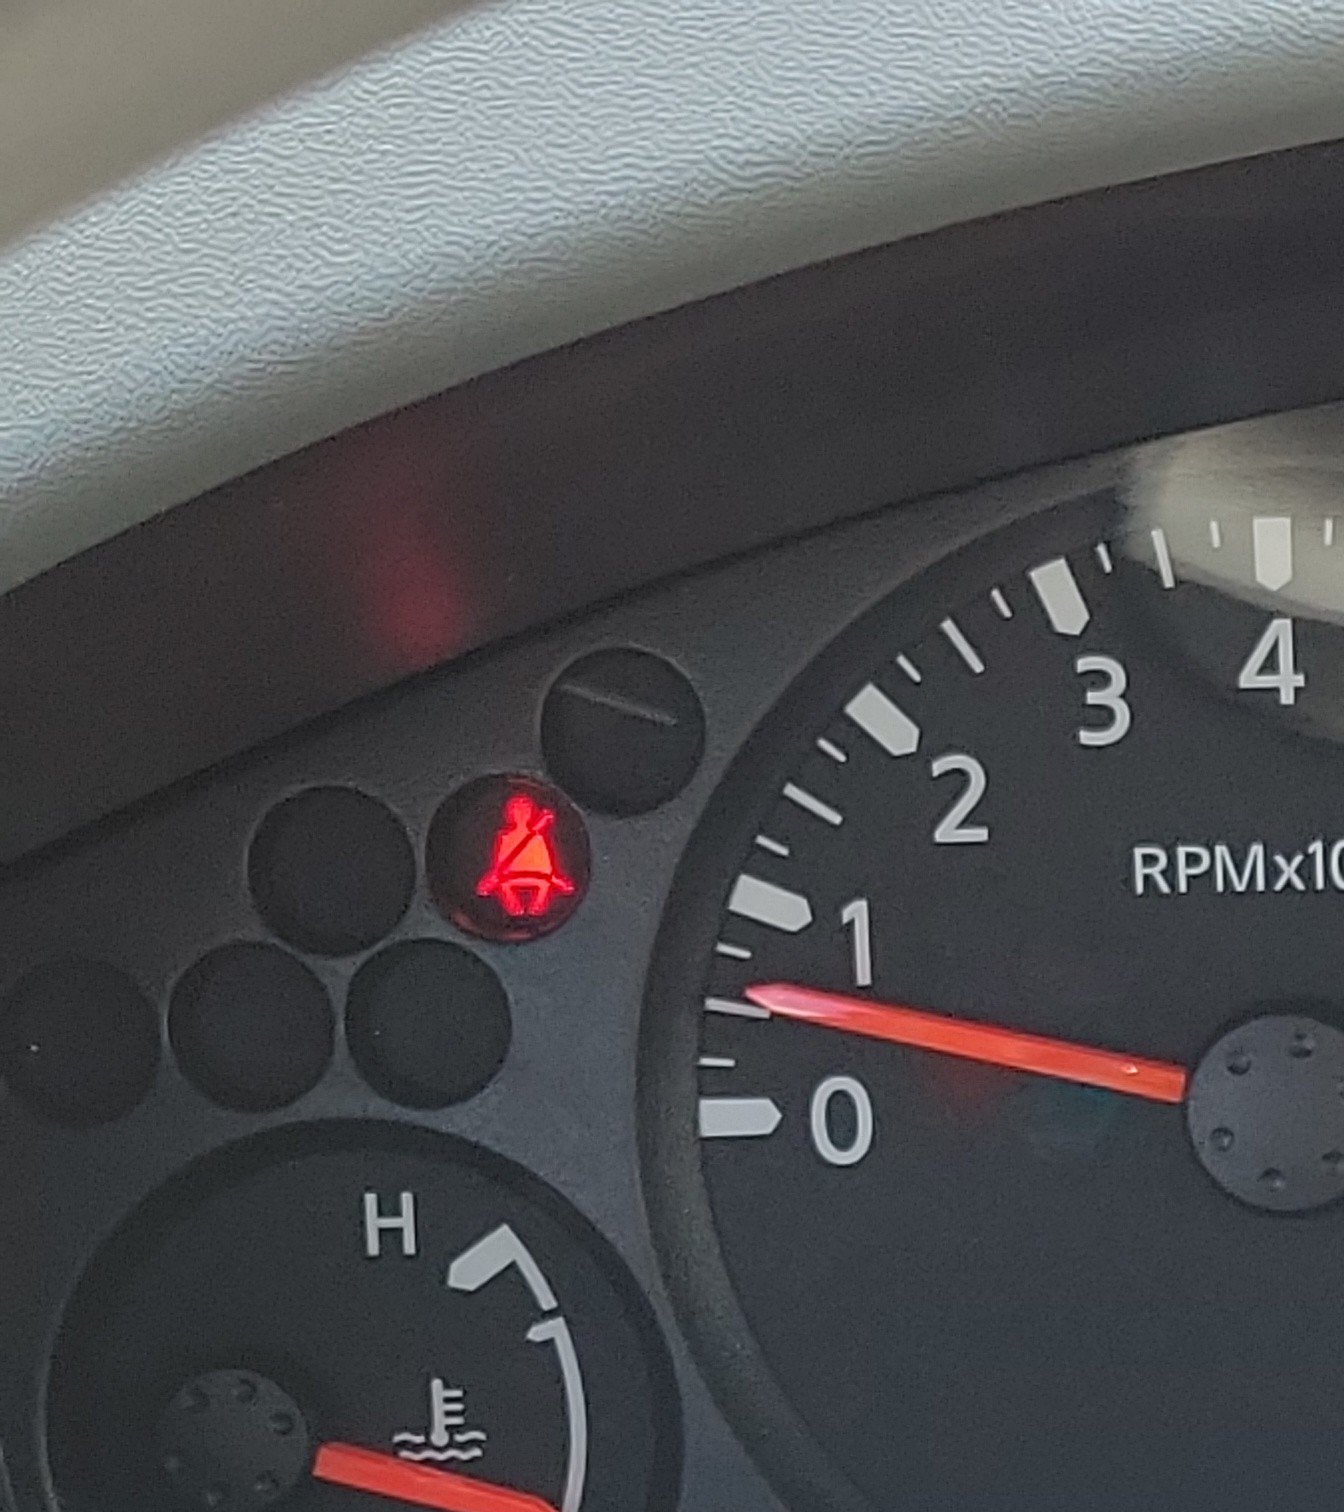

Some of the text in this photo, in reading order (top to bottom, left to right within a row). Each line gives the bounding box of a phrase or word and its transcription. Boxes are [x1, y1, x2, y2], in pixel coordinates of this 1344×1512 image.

[1076, 656, 1132, 746] 3
[1238, 618, 1305, 705] 4
[931, 754, 989, 844] 2
[841, 899, 873, 986] 1
[810, 1075, 875, 1165] 0
[363, 1192, 416, 1257] H
